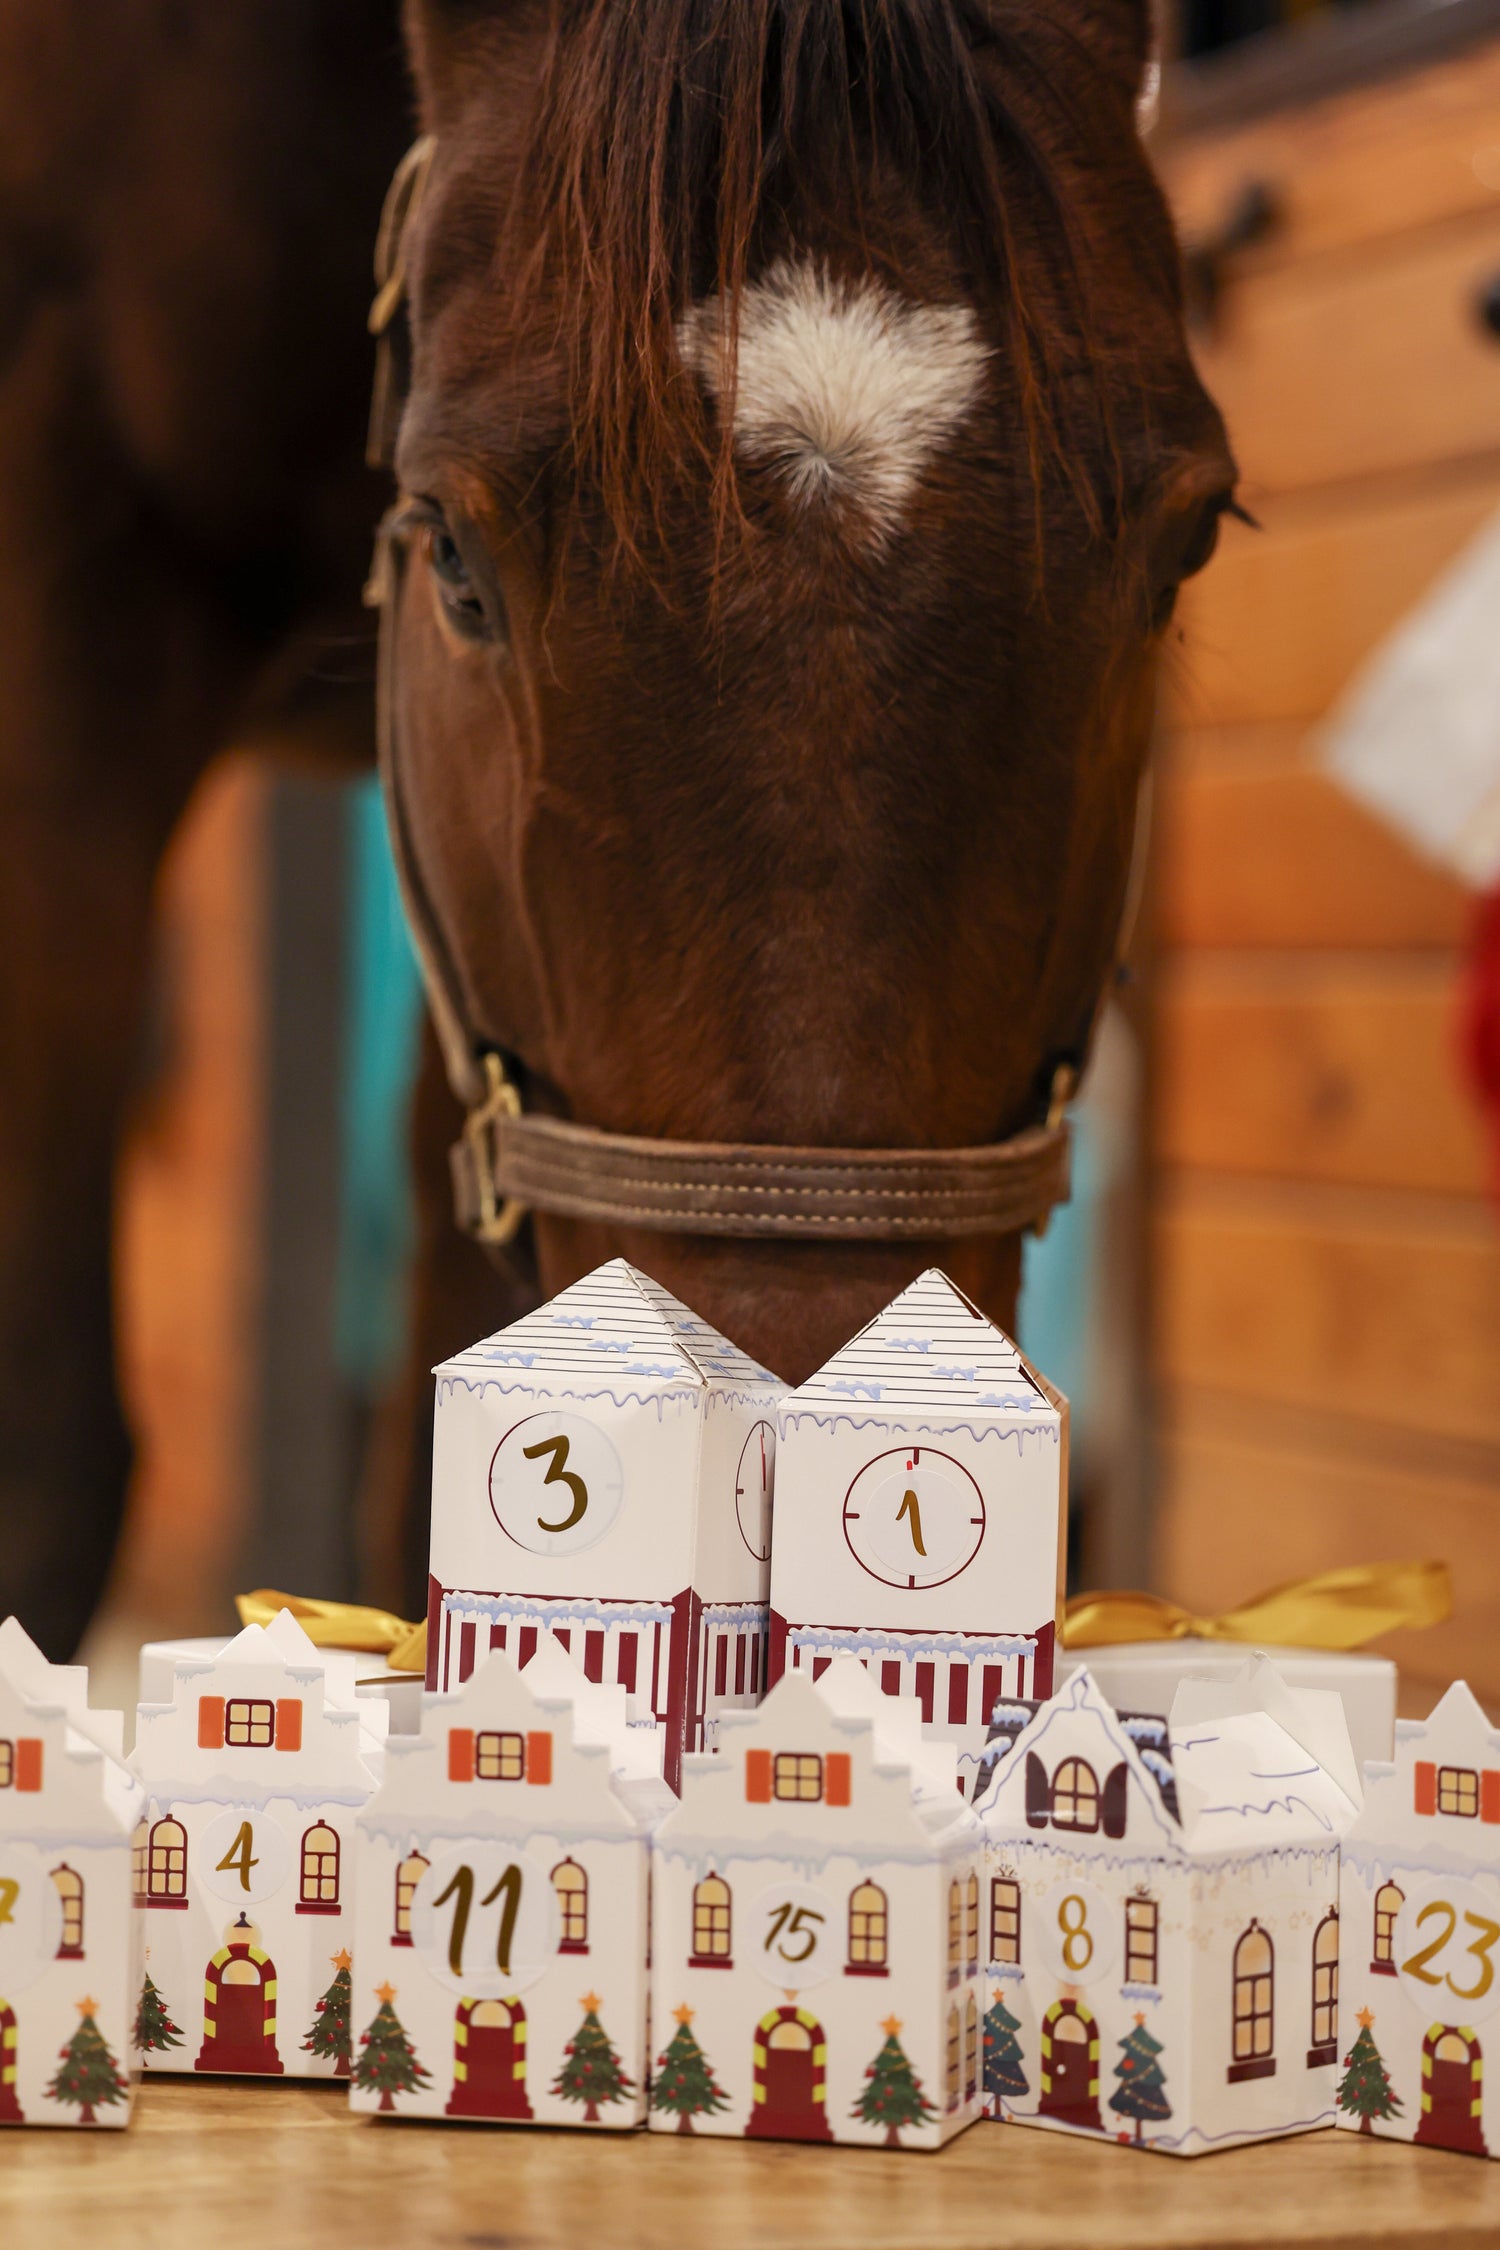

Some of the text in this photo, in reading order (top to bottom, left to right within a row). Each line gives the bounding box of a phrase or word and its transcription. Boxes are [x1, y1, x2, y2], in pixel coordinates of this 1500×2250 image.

[523, 1435, 588, 1532] 3
[895, 1489, 927, 1556] 1
[215, 1821, 258, 1891] 4
[433, 1864, 522, 1976] 11
[764, 1902, 825, 1962] 15
[1058, 1895, 1093, 1970] 8
[1402, 1900, 1500, 2000] 23
